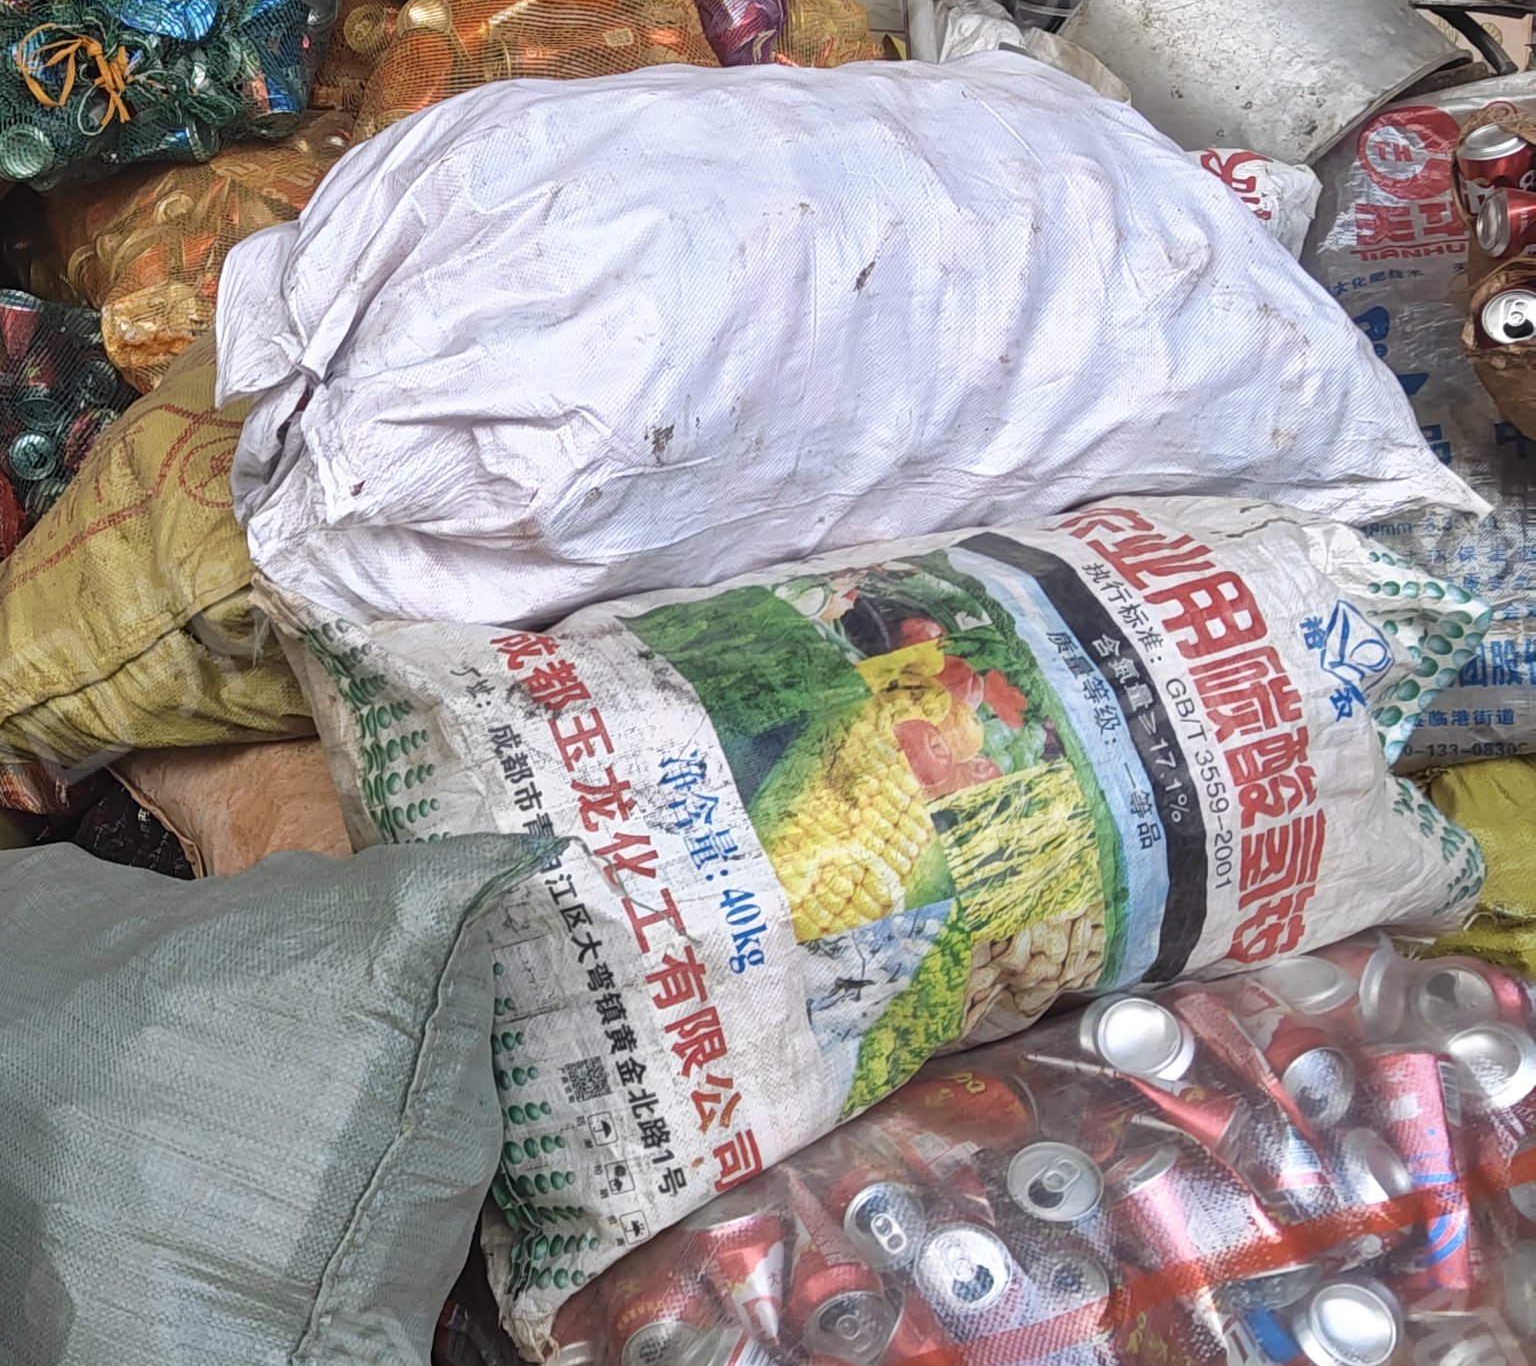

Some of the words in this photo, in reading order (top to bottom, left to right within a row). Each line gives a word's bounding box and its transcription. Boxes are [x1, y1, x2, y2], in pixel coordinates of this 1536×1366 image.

[491, 631, 765, 1195] 成都玉龙化工有限公司
[1194, 753, 1232, 890] 3559-2001
